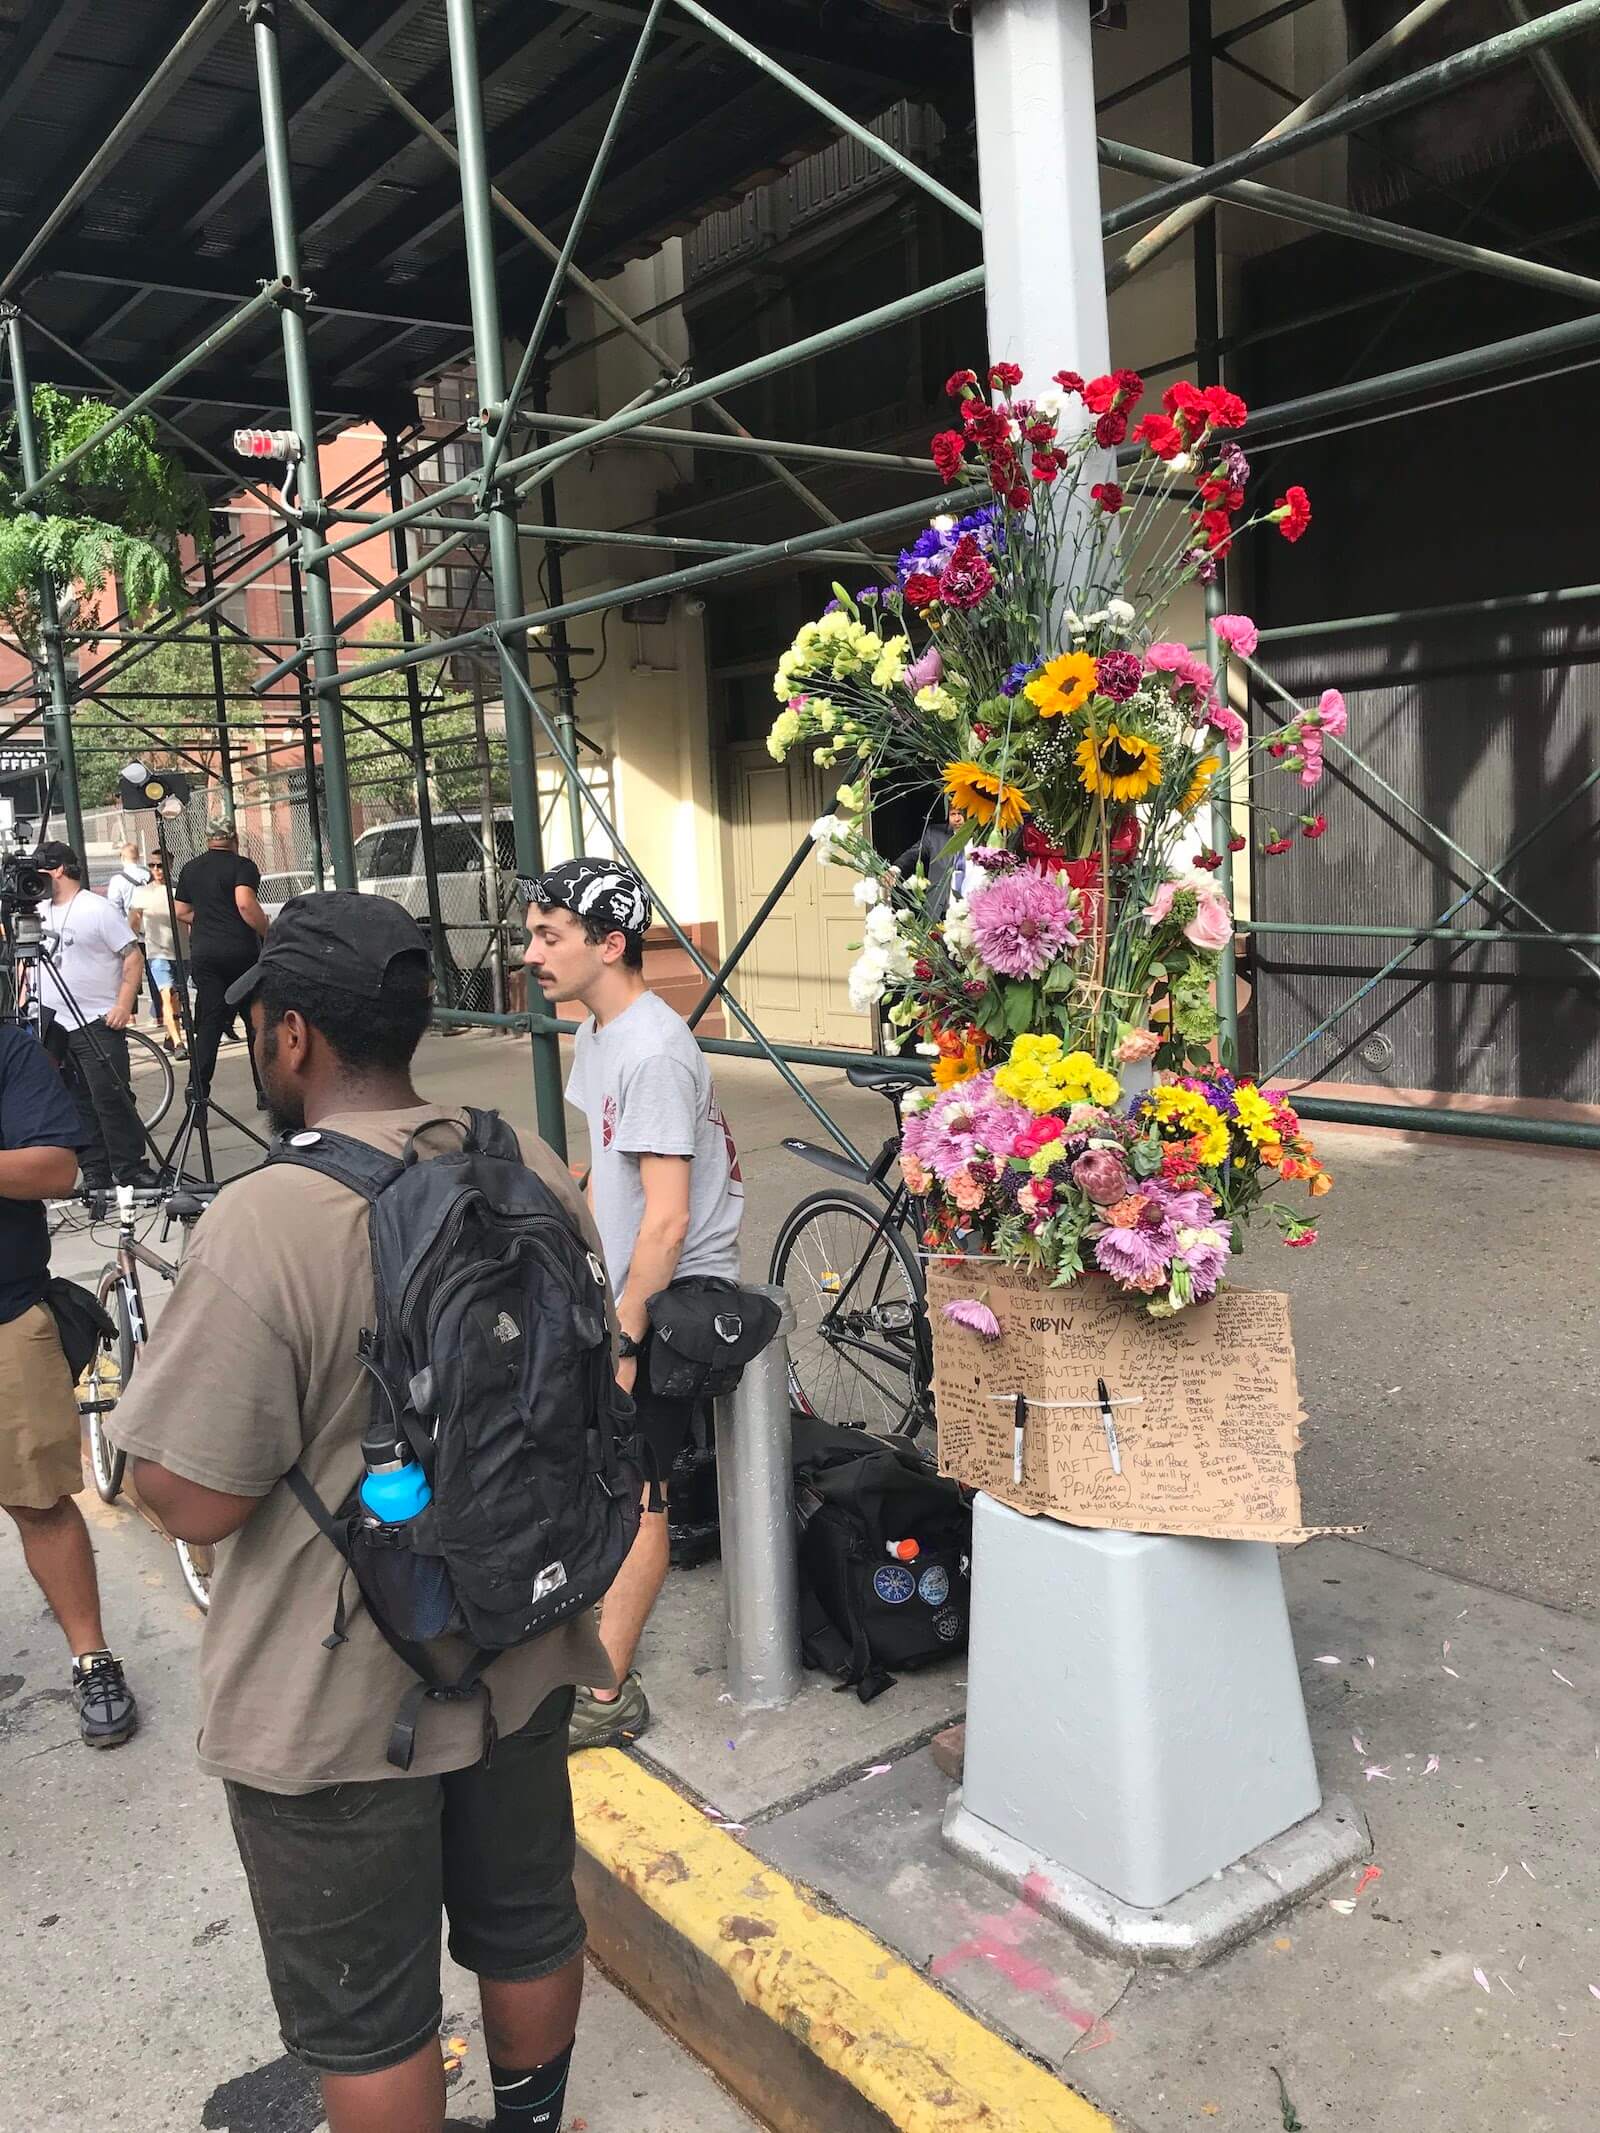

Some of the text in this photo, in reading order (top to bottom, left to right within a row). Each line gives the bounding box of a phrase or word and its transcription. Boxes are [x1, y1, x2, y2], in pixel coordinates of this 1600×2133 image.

[1063, 1297, 1105, 1312] PEACE
[1030, 1317, 1074, 1335] ROBYN
[1024, 1341, 1107, 1360] COURAGEOUS
[1033, 1363, 1113, 1379] BEAUTIFUL
[1181, 1369, 1222, 1378] THANK YOU
[1052, 1434, 1072, 1455] BY
[1057, 1457, 1099, 1474] MET
[1133, 1453, 1152, 1467] Ride
[1060, 1474, 1127, 1498] PANAMA
